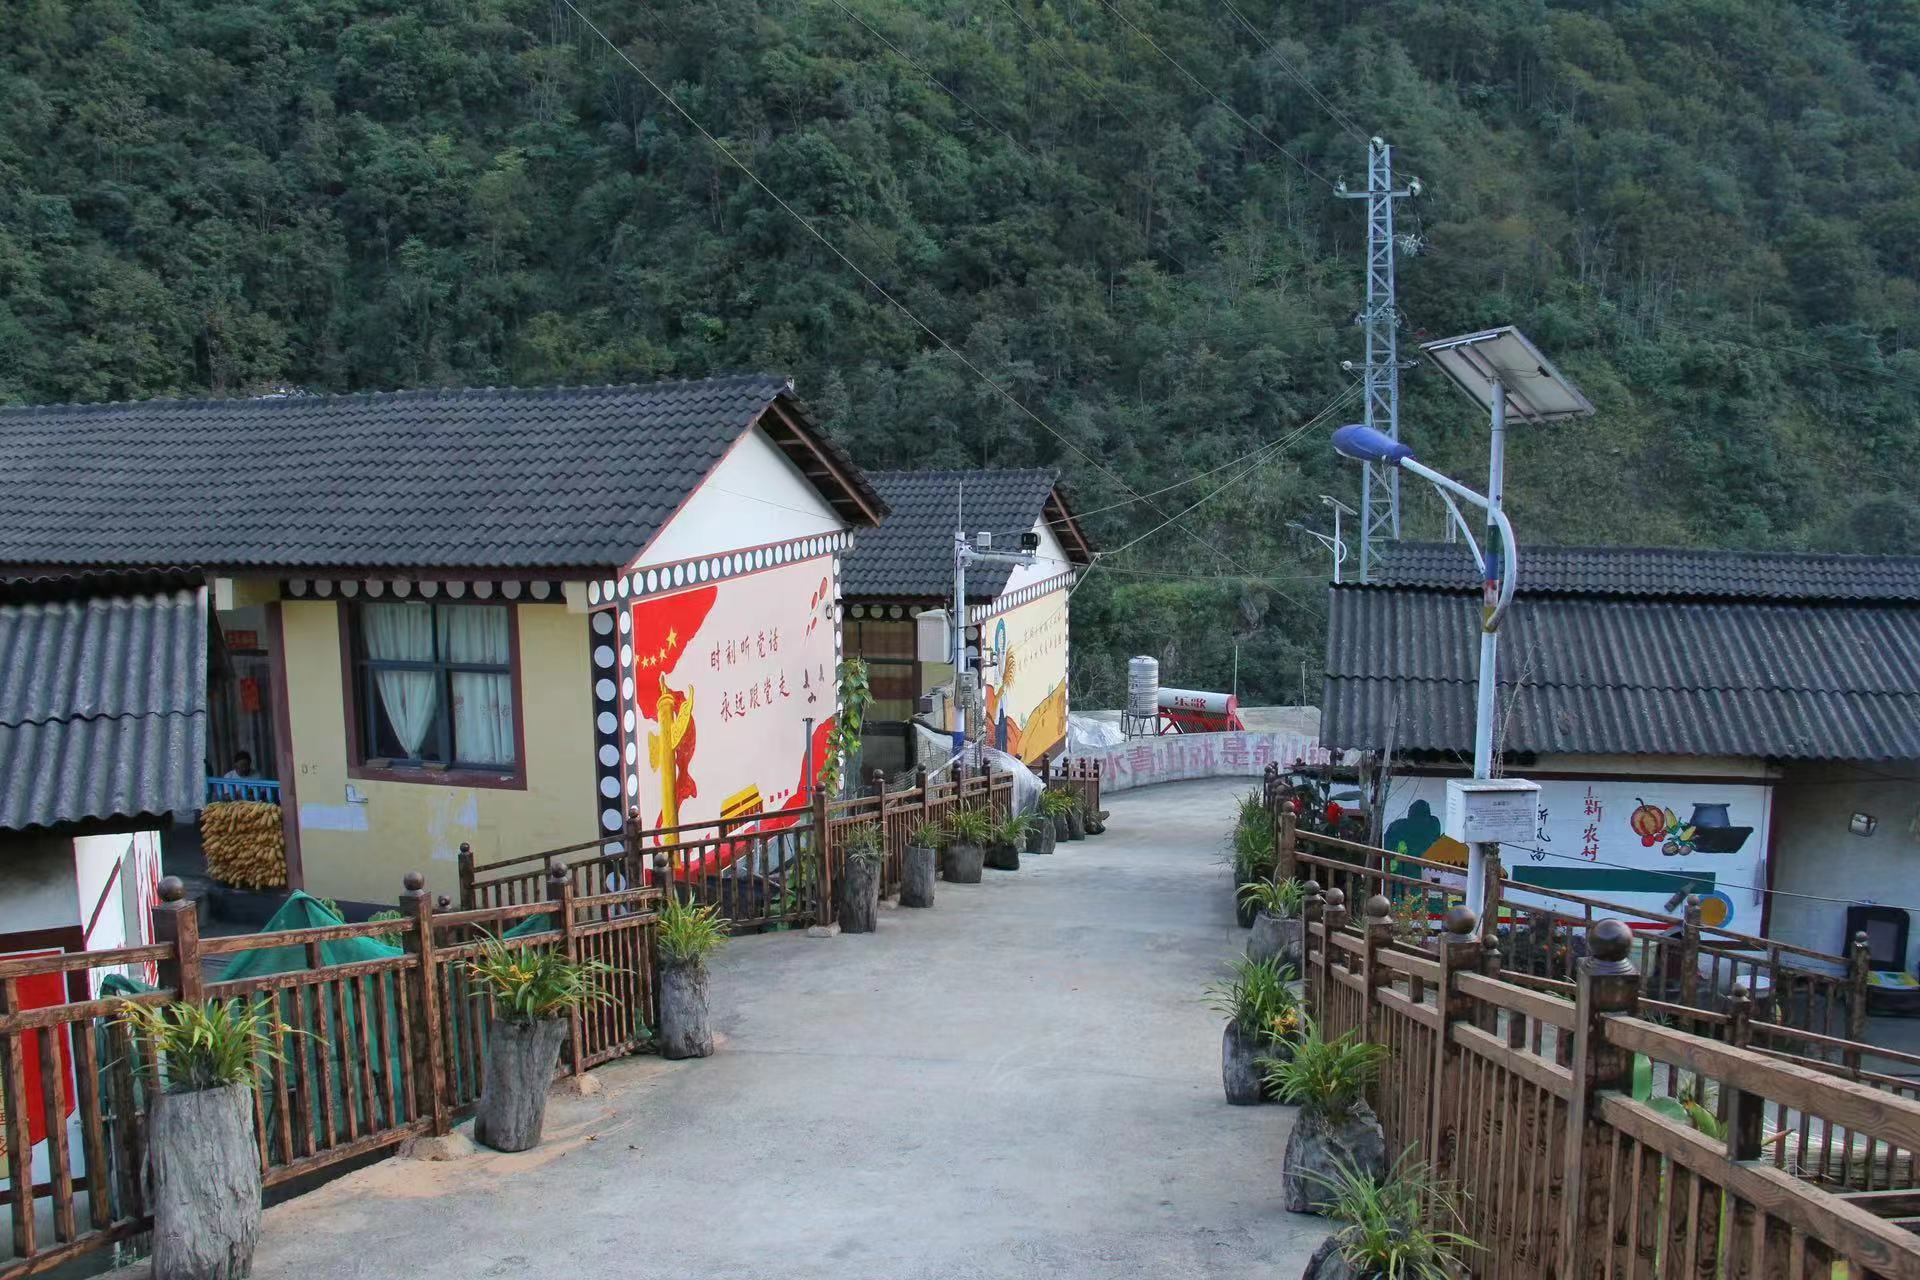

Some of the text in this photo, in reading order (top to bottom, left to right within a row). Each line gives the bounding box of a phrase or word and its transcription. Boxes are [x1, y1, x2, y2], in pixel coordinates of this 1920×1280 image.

[710, 626, 779, 672] 时刻听党话
[720, 668, 791, 723] 永远跟党走
[1581, 785, 1604, 862] 新农村
